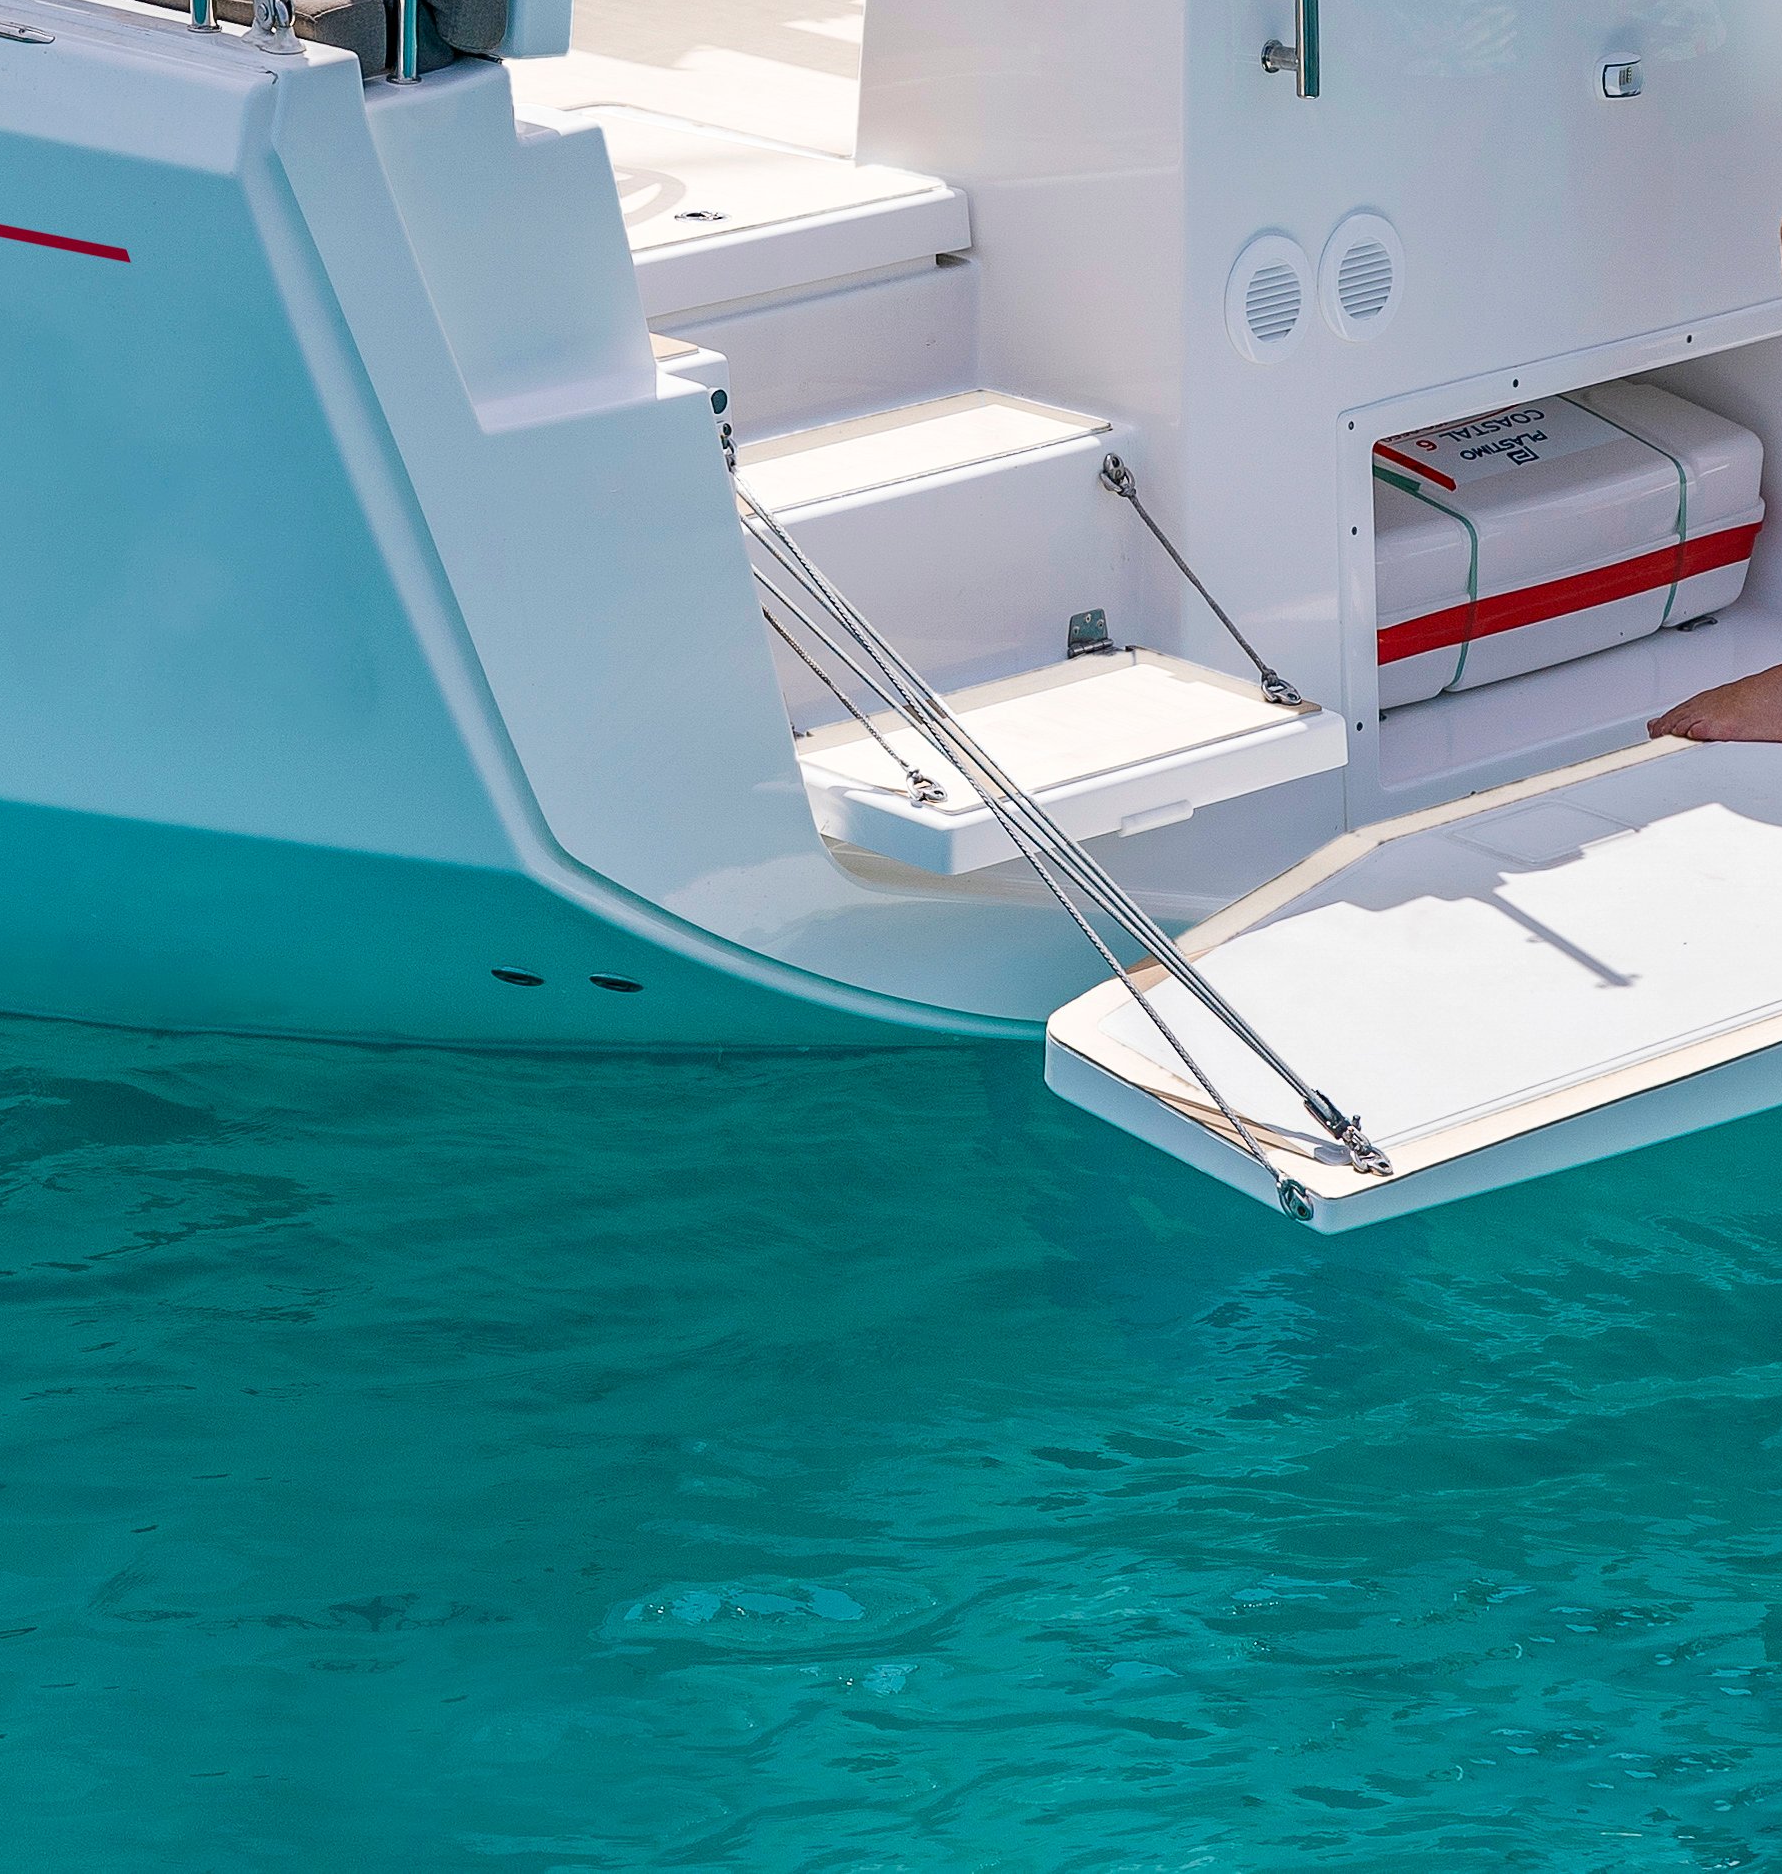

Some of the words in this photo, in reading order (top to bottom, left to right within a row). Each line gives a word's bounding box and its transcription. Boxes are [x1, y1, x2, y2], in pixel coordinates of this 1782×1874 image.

[1438, 409, 1546, 443] COASTAL
[1415, 439, 1438, 452] 6
[1459, 429, 1549, 461] PLASTIMO
